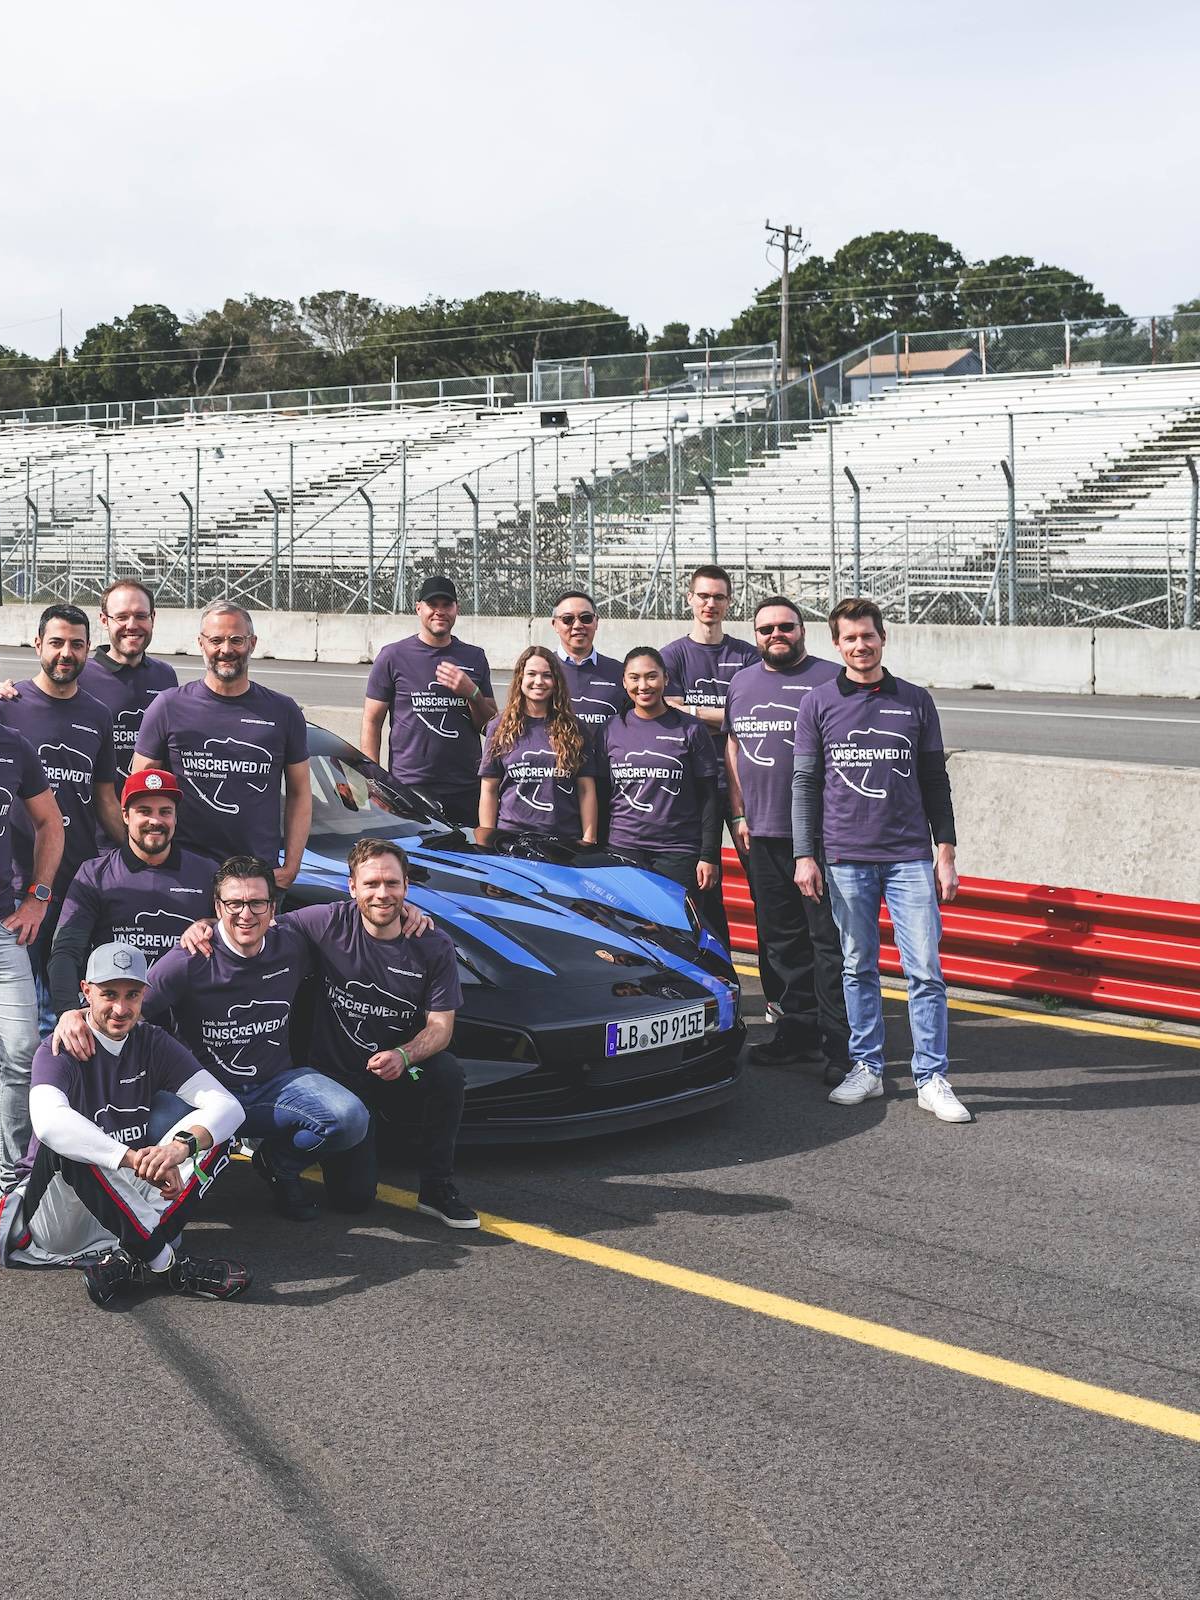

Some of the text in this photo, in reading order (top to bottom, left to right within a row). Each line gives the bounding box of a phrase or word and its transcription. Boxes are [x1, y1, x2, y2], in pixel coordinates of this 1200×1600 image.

[685, 694, 727, 705] NSCREW
[241, 718, 275, 726] PORSCHE
[734, 720, 792, 732] UNSCREWED
[831, 748, 900, 760] UNSCREWED
[182, 757, 271, 774] UNSCREWED IT!
[611, 767, 683, 780] UNSCREWED IT!
[387, 966, 423, 979] PORSCHE
[202, 1019, 216, 1027] Look,
[202, 1019, 280, 1040] UNSCREWED
[617, 1025, 638, 1051] LB
[650, 1020, 668, 1045] SP
[671, 1010, 703, 1041] 915E
